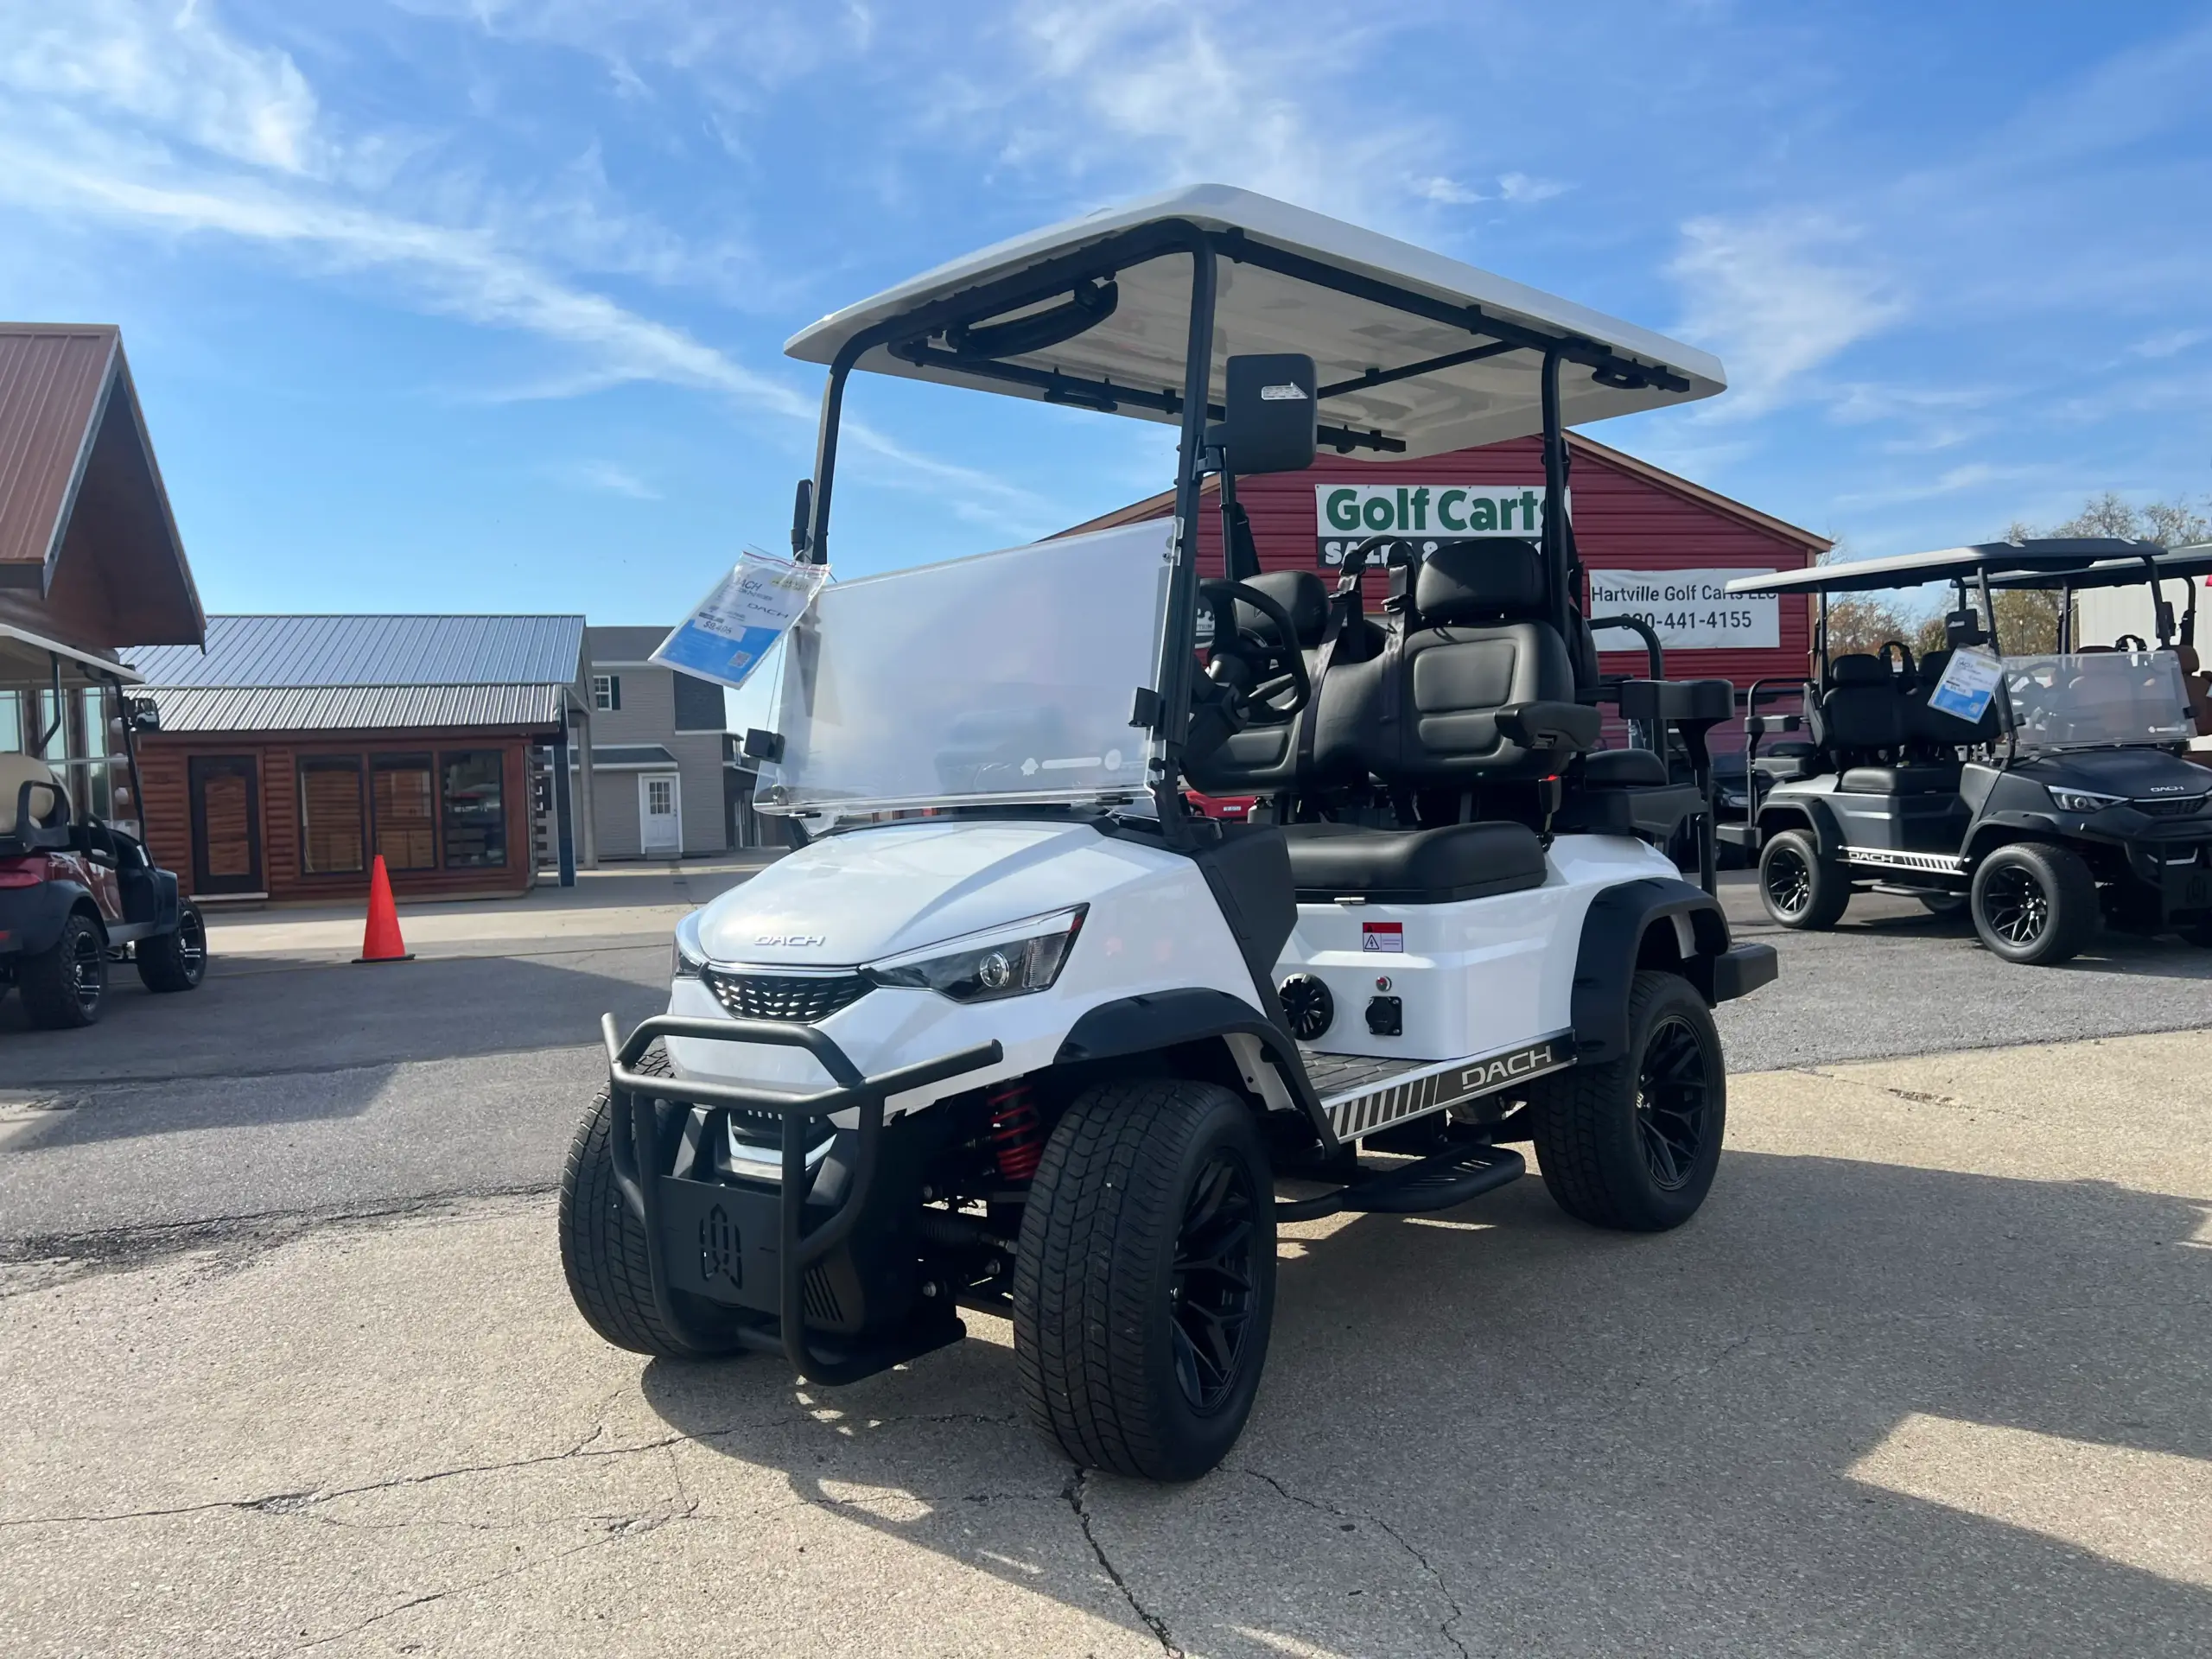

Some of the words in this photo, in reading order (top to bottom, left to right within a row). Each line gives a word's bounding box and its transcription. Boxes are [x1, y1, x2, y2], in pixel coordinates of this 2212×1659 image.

[1326, 488, 1430, 531] Golf
[1438, 490, 1547, 531] Cart
[1592, 586, 1659, 602] Hartville
[1664, 585, 1696, 601] Golf
[747, 602, 789, 620] DACH
[1621, 611, 1752, 631] 0-441-4155
[1849, 851, 1894, 863] DACH
[753, 935, 826, 947] DACH
[1461, 1045, 1552, 1090] DACH
